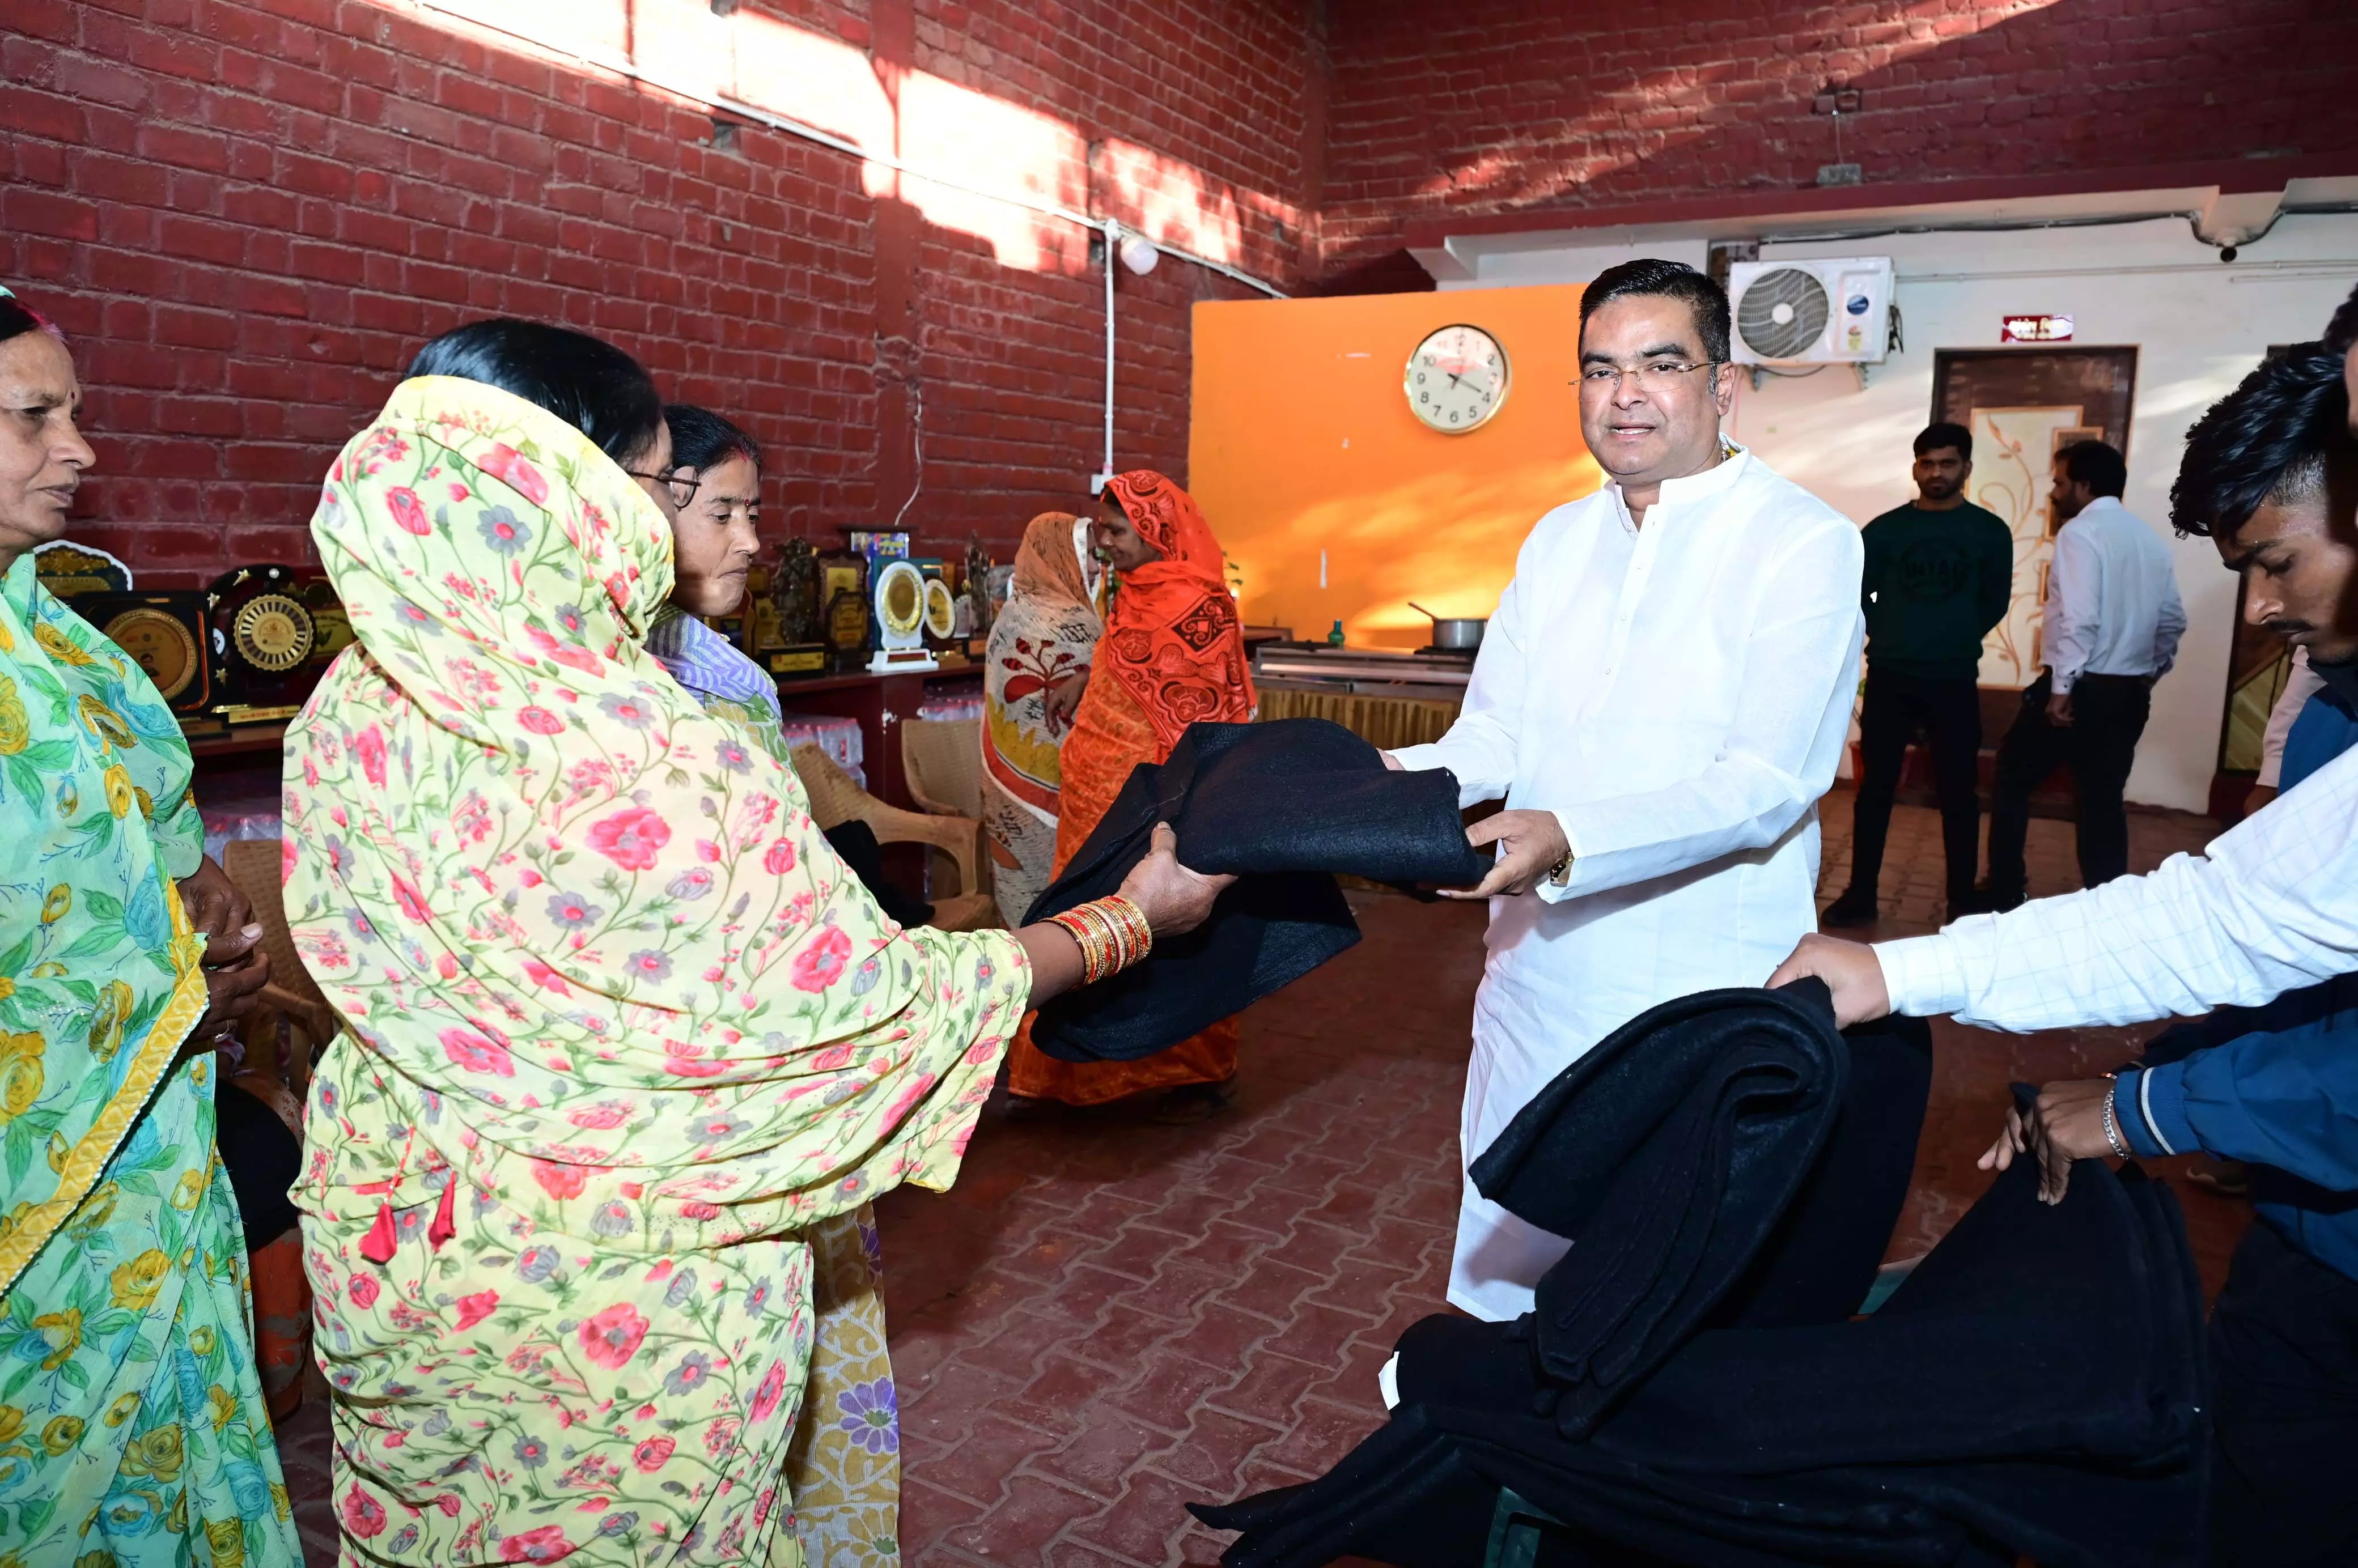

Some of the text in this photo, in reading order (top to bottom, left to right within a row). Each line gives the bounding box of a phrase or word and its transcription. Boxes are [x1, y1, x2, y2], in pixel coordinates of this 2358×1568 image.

[1423, 355, 1436, 367] 10
[1487, 354, 1495, 366] 2
[1417, 372, 1426, 385] 9
[1489, 372, 1497, 385] 3
[1420, 391, 1429, 404] 8
[1481, 392, 1490, 403] 4
[1433, 405, 1441, 417] 7
[1450, 411, 1458, 423] 6
[1469, 406, 1477, 418] 5
